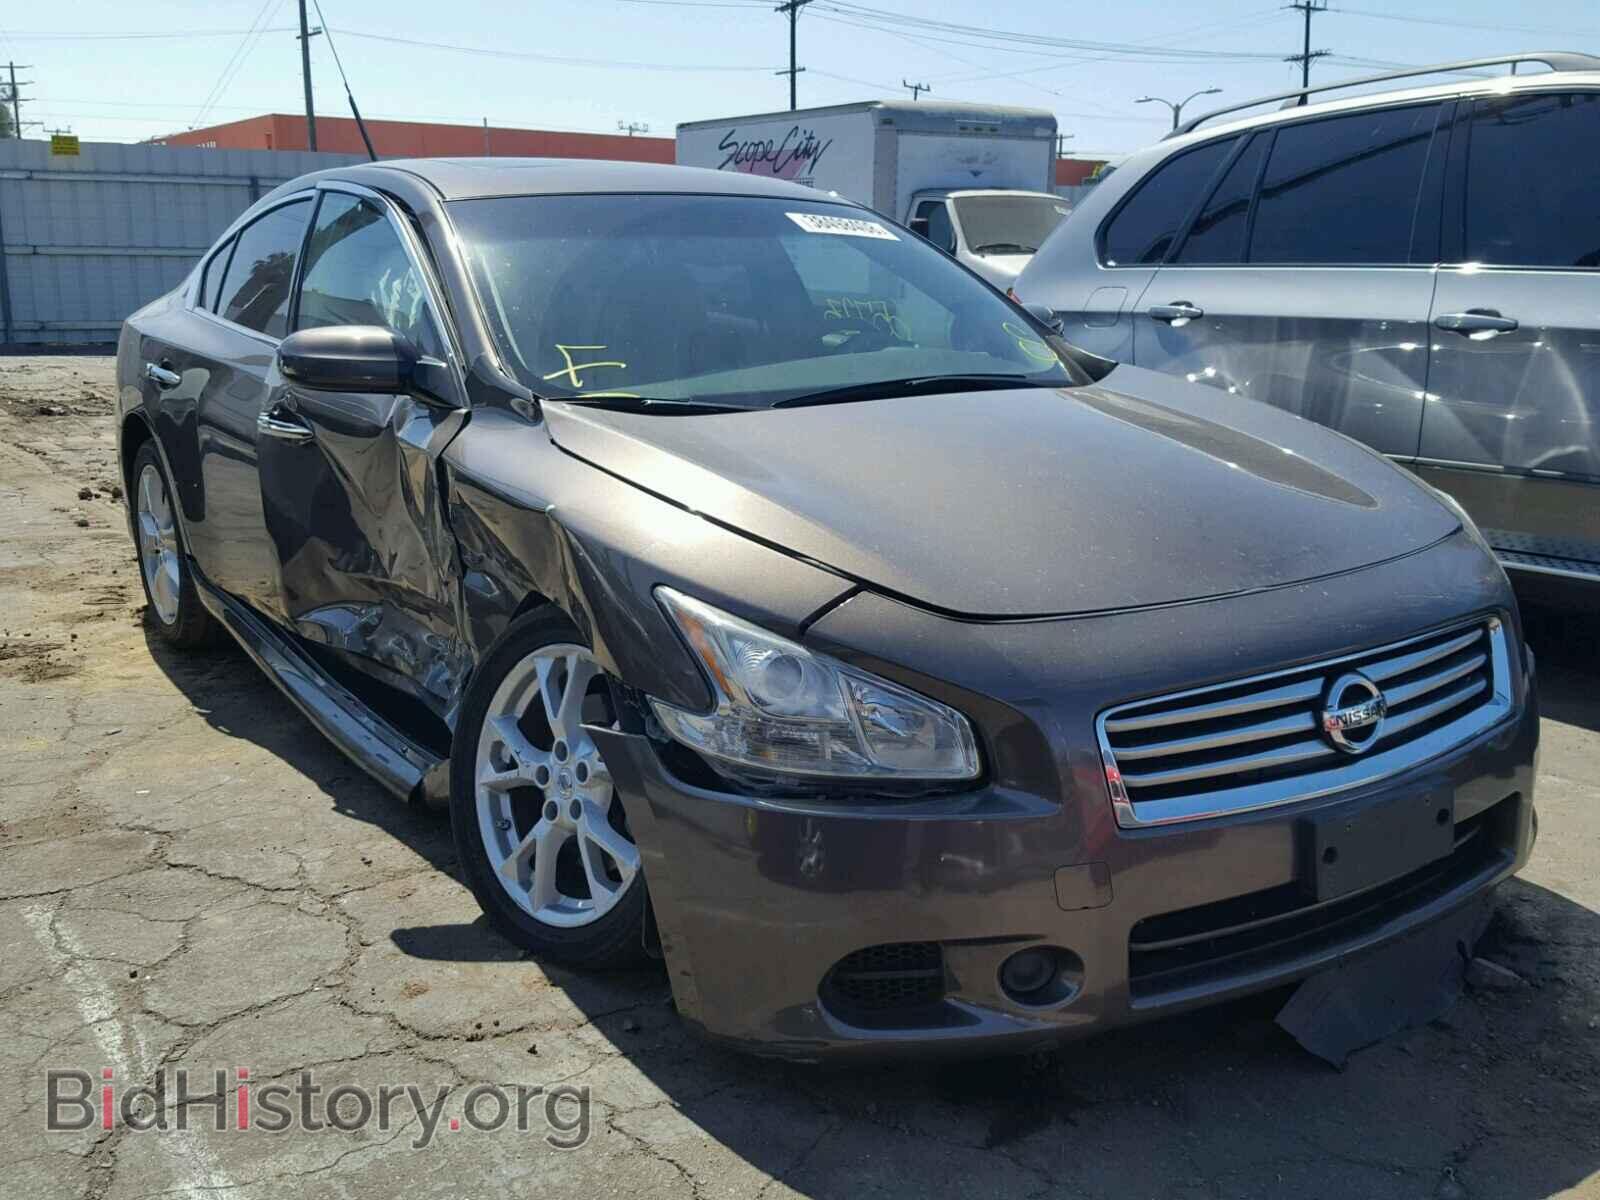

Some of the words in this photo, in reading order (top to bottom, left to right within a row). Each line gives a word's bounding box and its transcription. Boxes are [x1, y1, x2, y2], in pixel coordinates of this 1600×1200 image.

[717, 128, 775, 171] Scope
[772, 125, 833, 175] City
[1328, 701, 1386, 728] NISSAN
